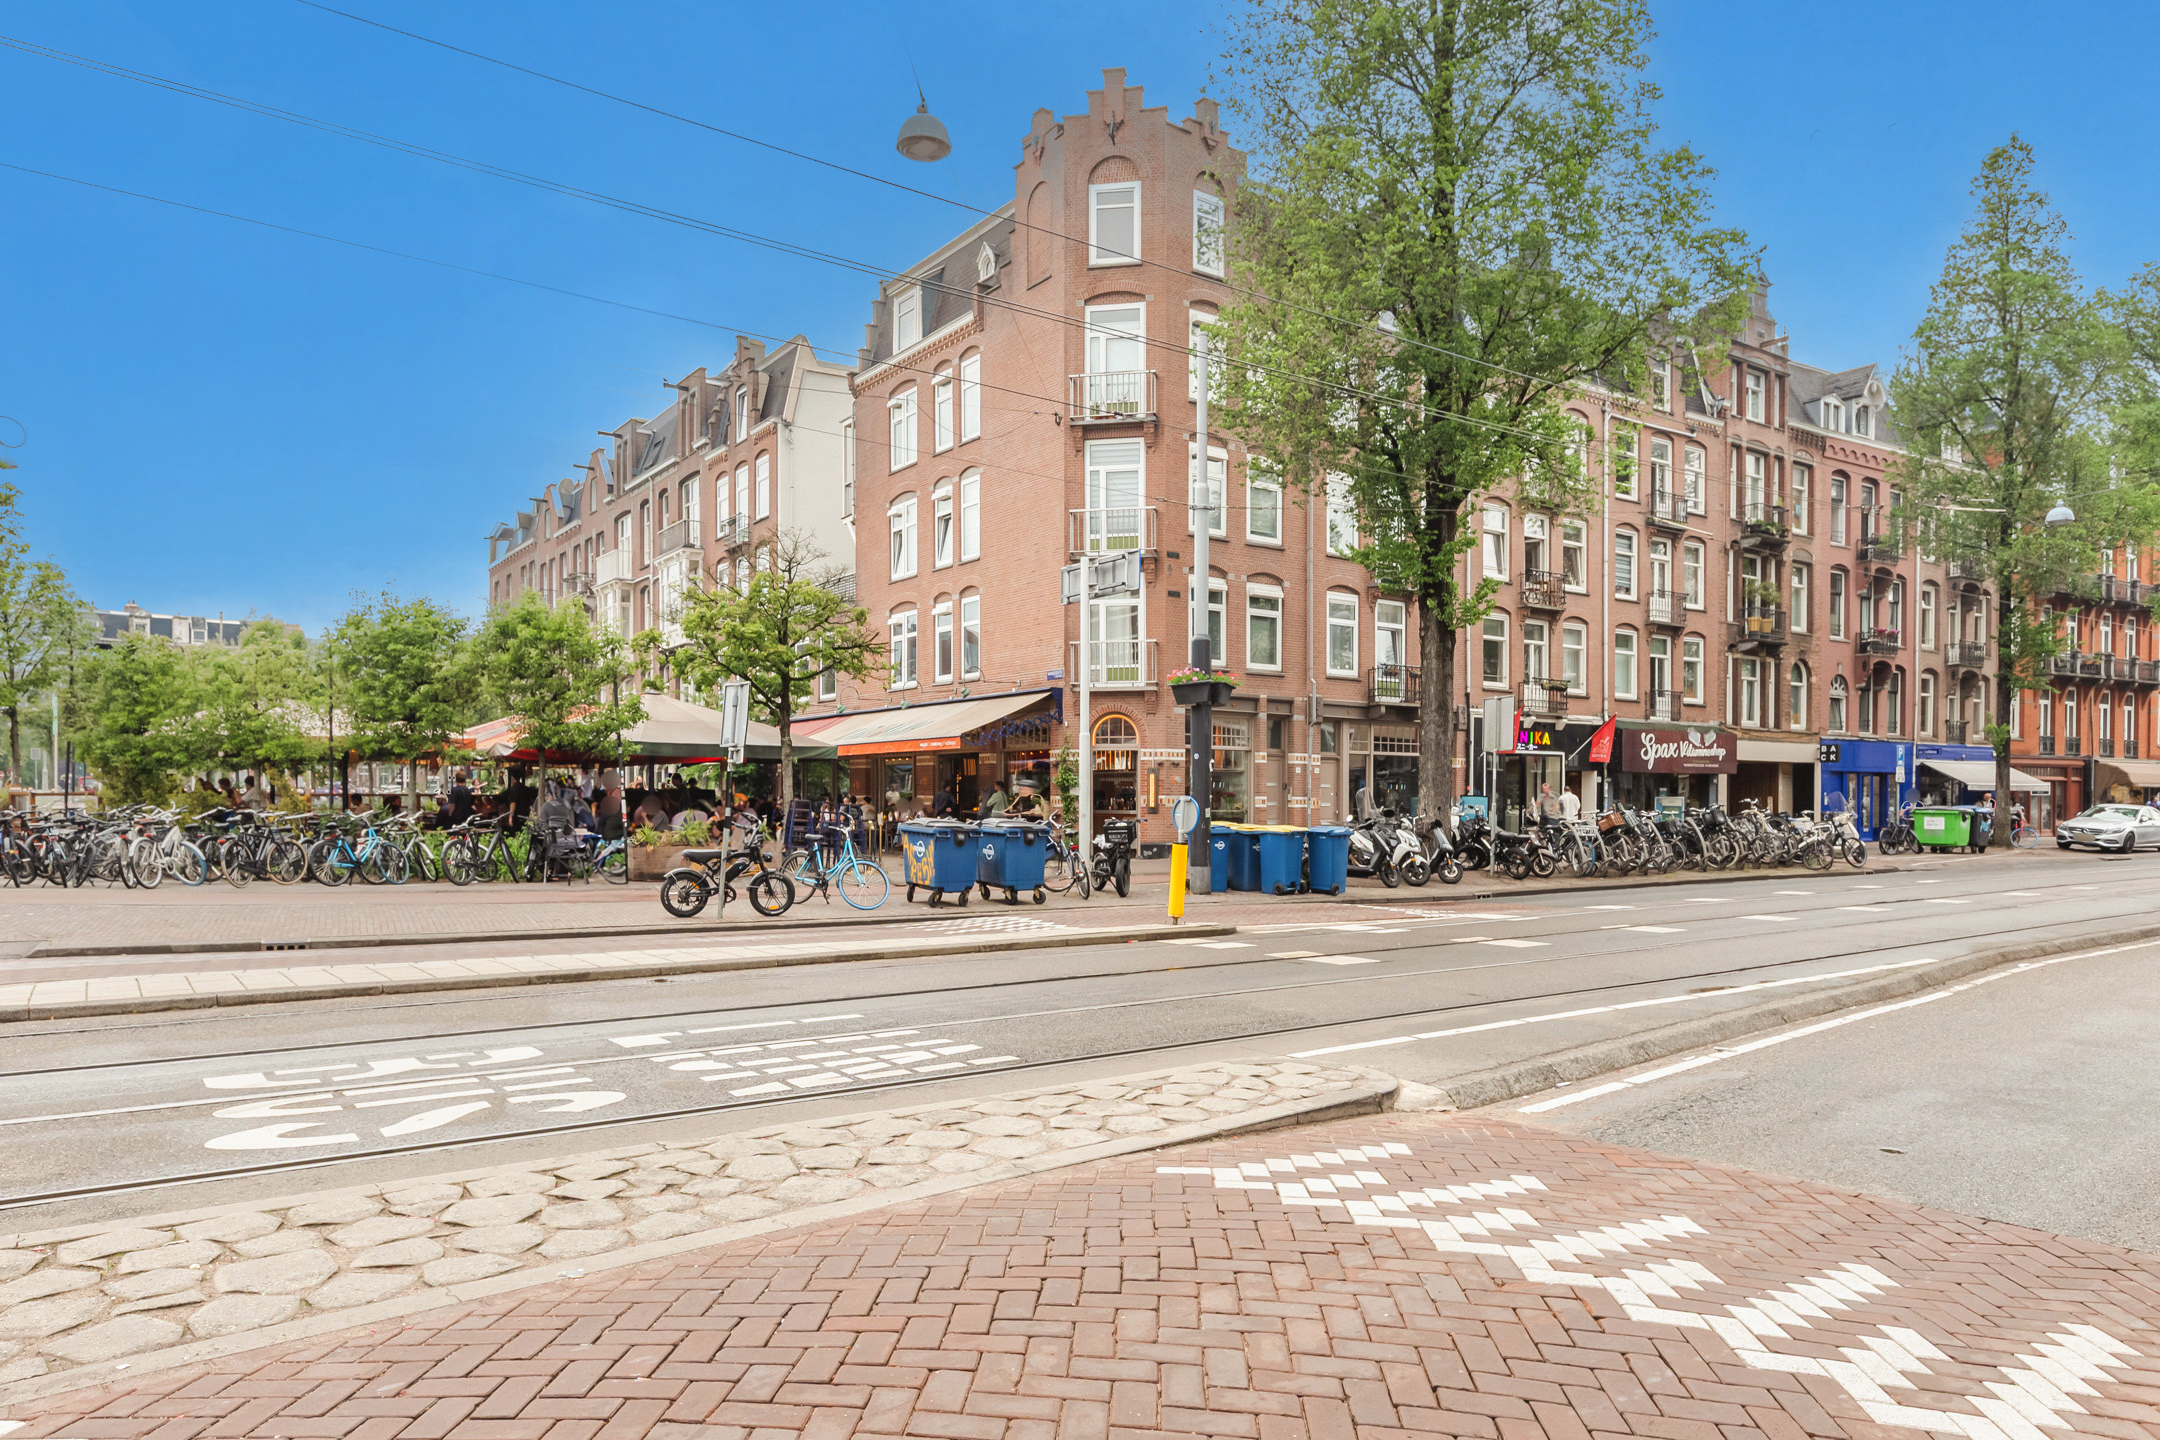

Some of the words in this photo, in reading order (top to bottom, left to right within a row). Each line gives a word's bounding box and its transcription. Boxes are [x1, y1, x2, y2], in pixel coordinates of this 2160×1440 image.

[1640, 732, 1679, 770] Spax
[203, 1046, 627, 1151] BUS
[608, 1013, 1021, 1099] LIJN
